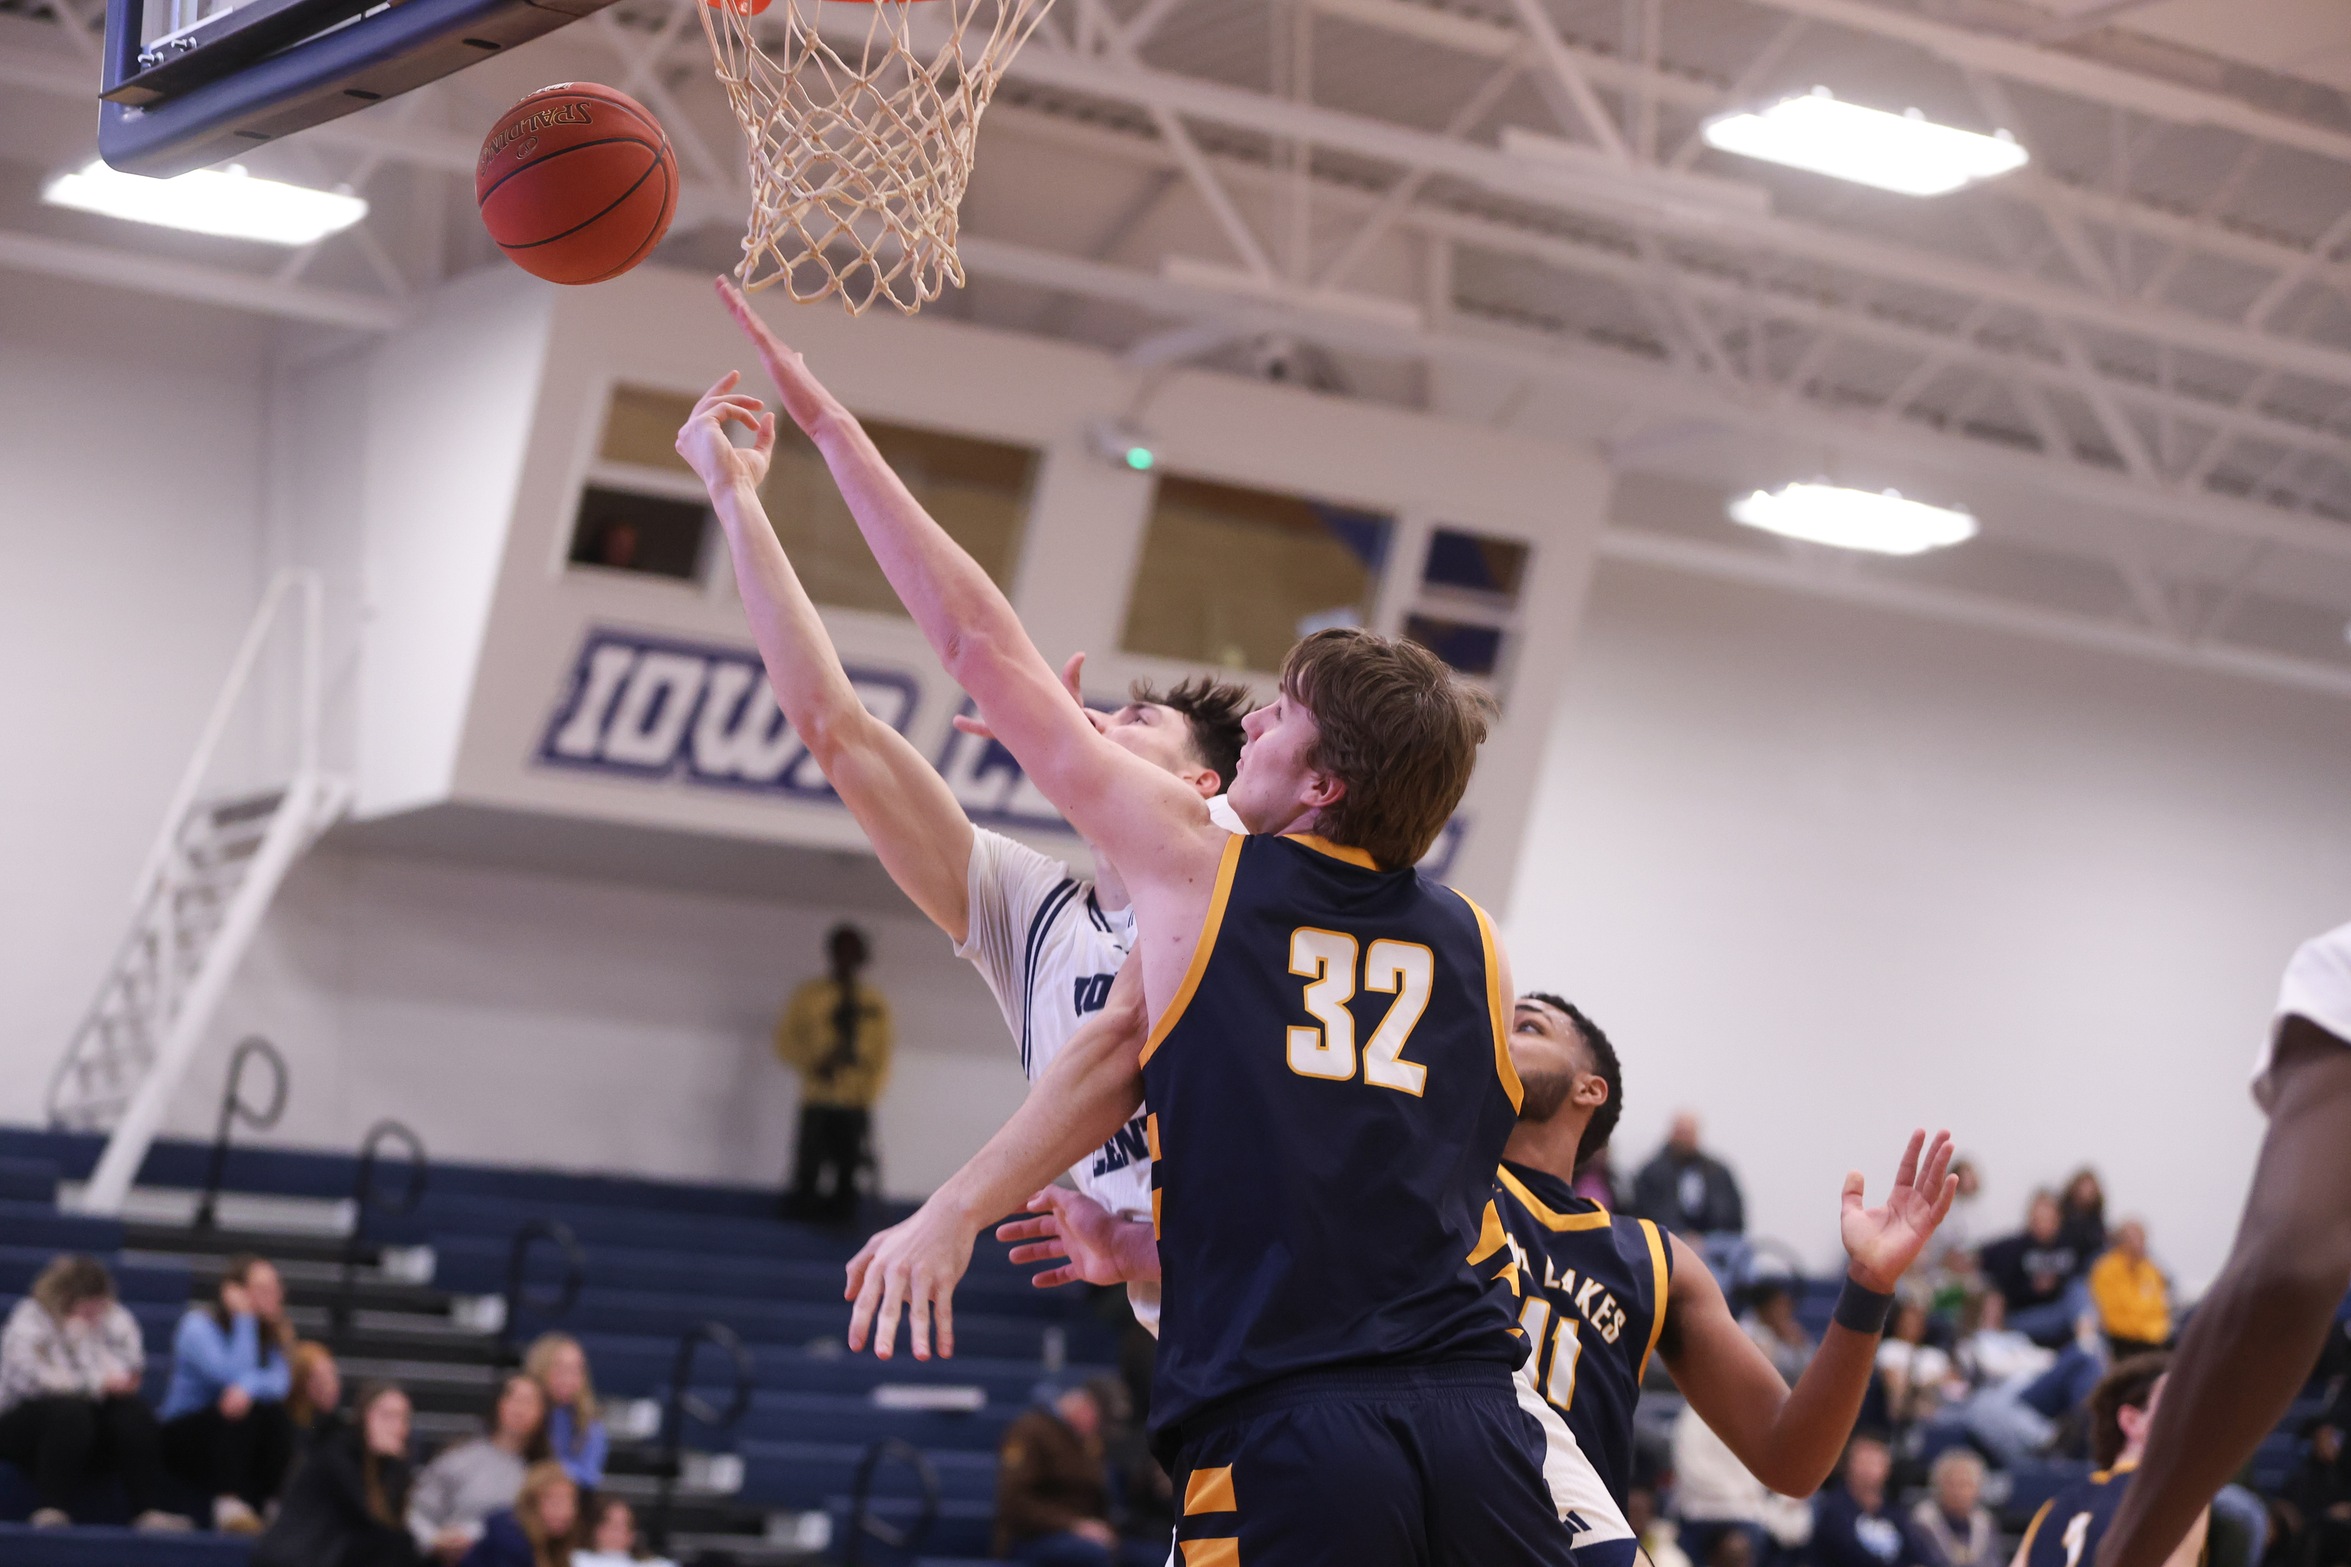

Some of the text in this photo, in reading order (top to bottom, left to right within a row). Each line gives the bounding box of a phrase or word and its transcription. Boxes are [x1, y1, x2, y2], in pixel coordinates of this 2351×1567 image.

[480, 101, 594, 177] SPALDING
[1286, 925, 1435, 1098] 32
[1543, 1253, 1627, 1345] LAKES
[1517, 1295, 1583, 1411] 11
